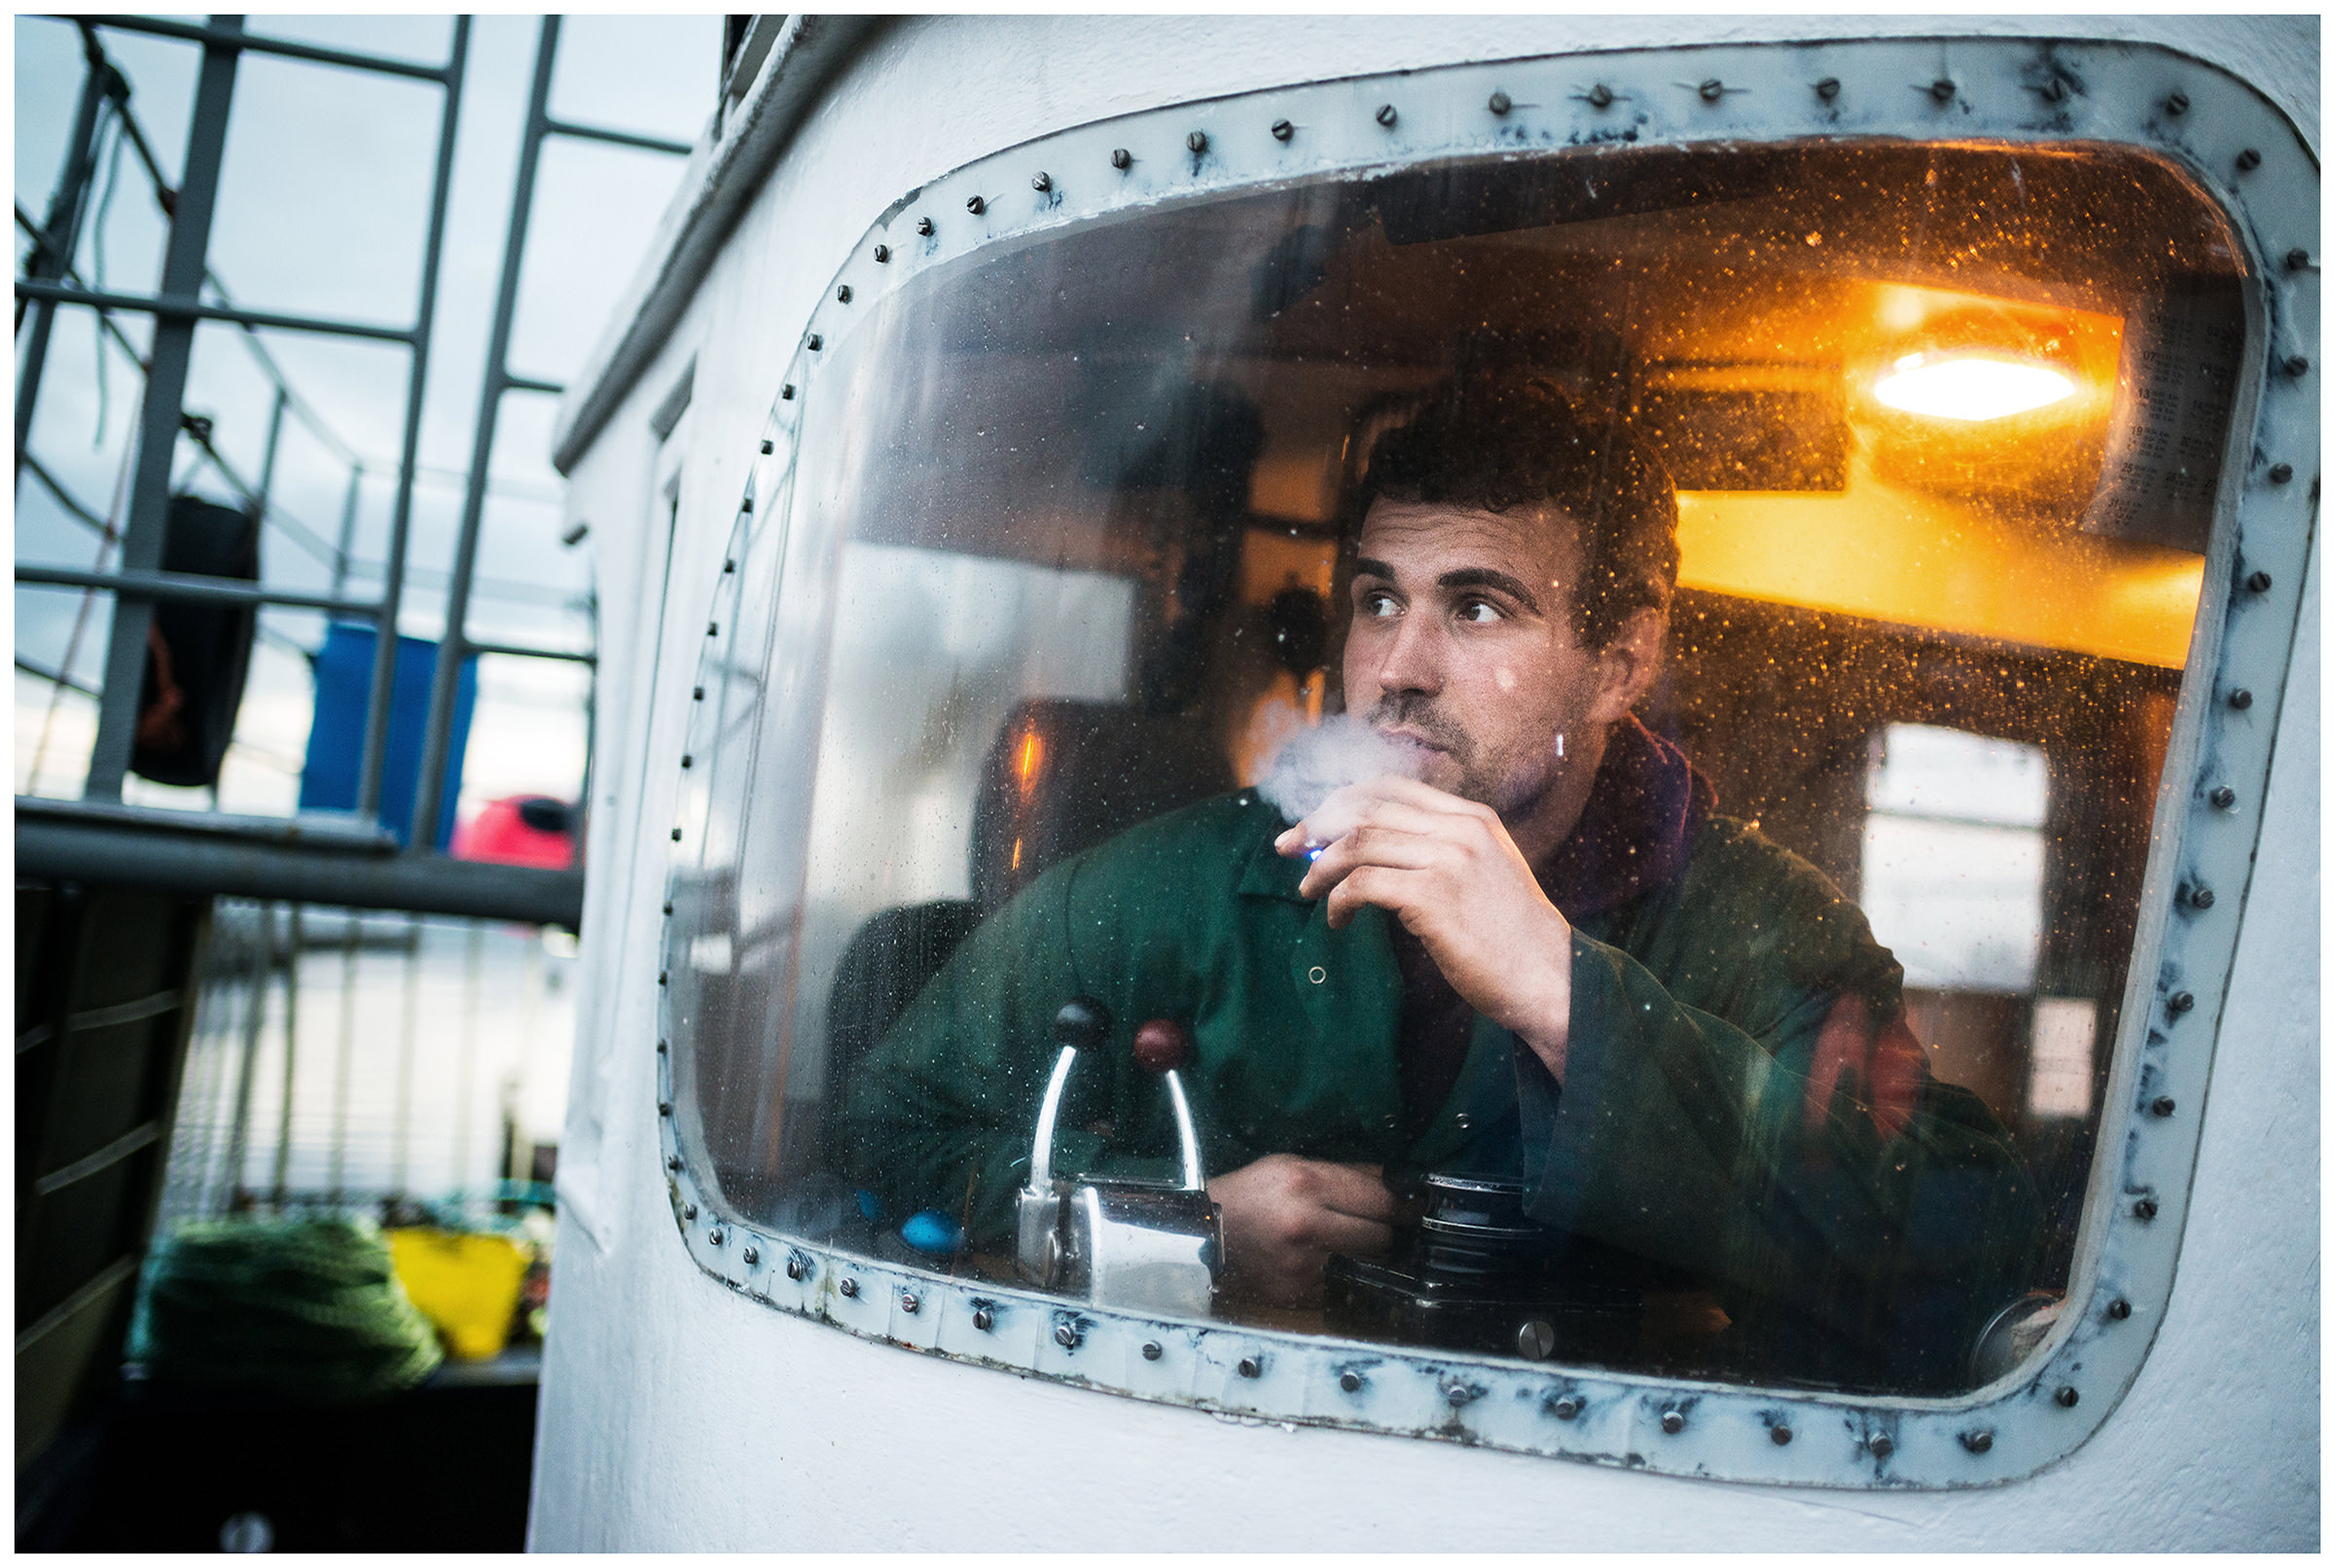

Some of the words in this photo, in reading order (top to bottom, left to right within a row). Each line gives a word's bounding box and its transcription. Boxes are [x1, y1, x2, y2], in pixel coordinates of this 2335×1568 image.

[2142, 350, 2156, 362] 07
[2138, 388, 2150, 399] 13
[2132, 426, 2143, 437] 19
[2121, 462, 2133, 474] 25
[2107, 498, 2119, 508] 31
